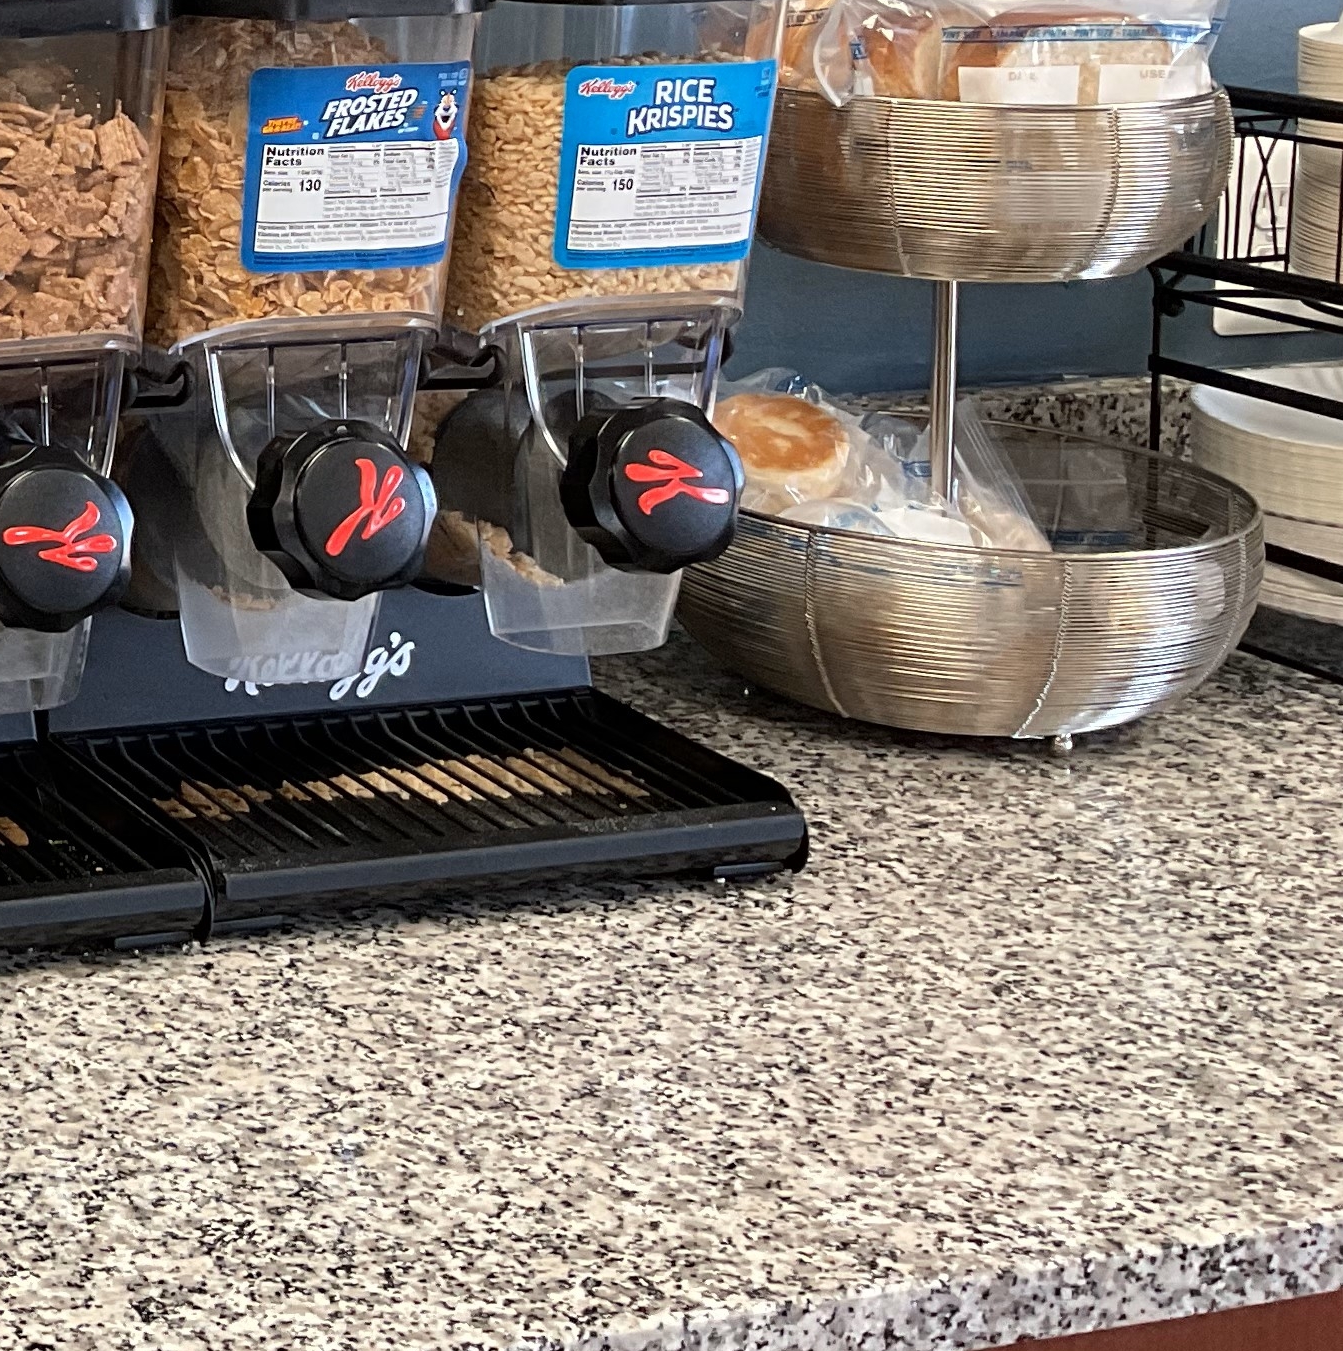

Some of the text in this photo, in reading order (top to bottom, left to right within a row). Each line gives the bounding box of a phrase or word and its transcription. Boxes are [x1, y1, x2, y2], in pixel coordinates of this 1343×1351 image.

[346, 71, 403, 94] Kellogg's
[578, 78, 637, 99] Kellogg's
[655, 78, 717, 105] RICE
[322, 89, 418, 121] FROSTED
[325, 108, 408, 138] FLAKES
[627, 105, 734, 136] KRISPIES
[266, 146, 325, 157] Nutrition
[580, 146, 637, 157] Nutrition
[265, 157, 302, 166] Facts
[579, 157, 616, 166] Facts
[299, 179, 322, 192] 130
[612, 178, 634, 191] 150
